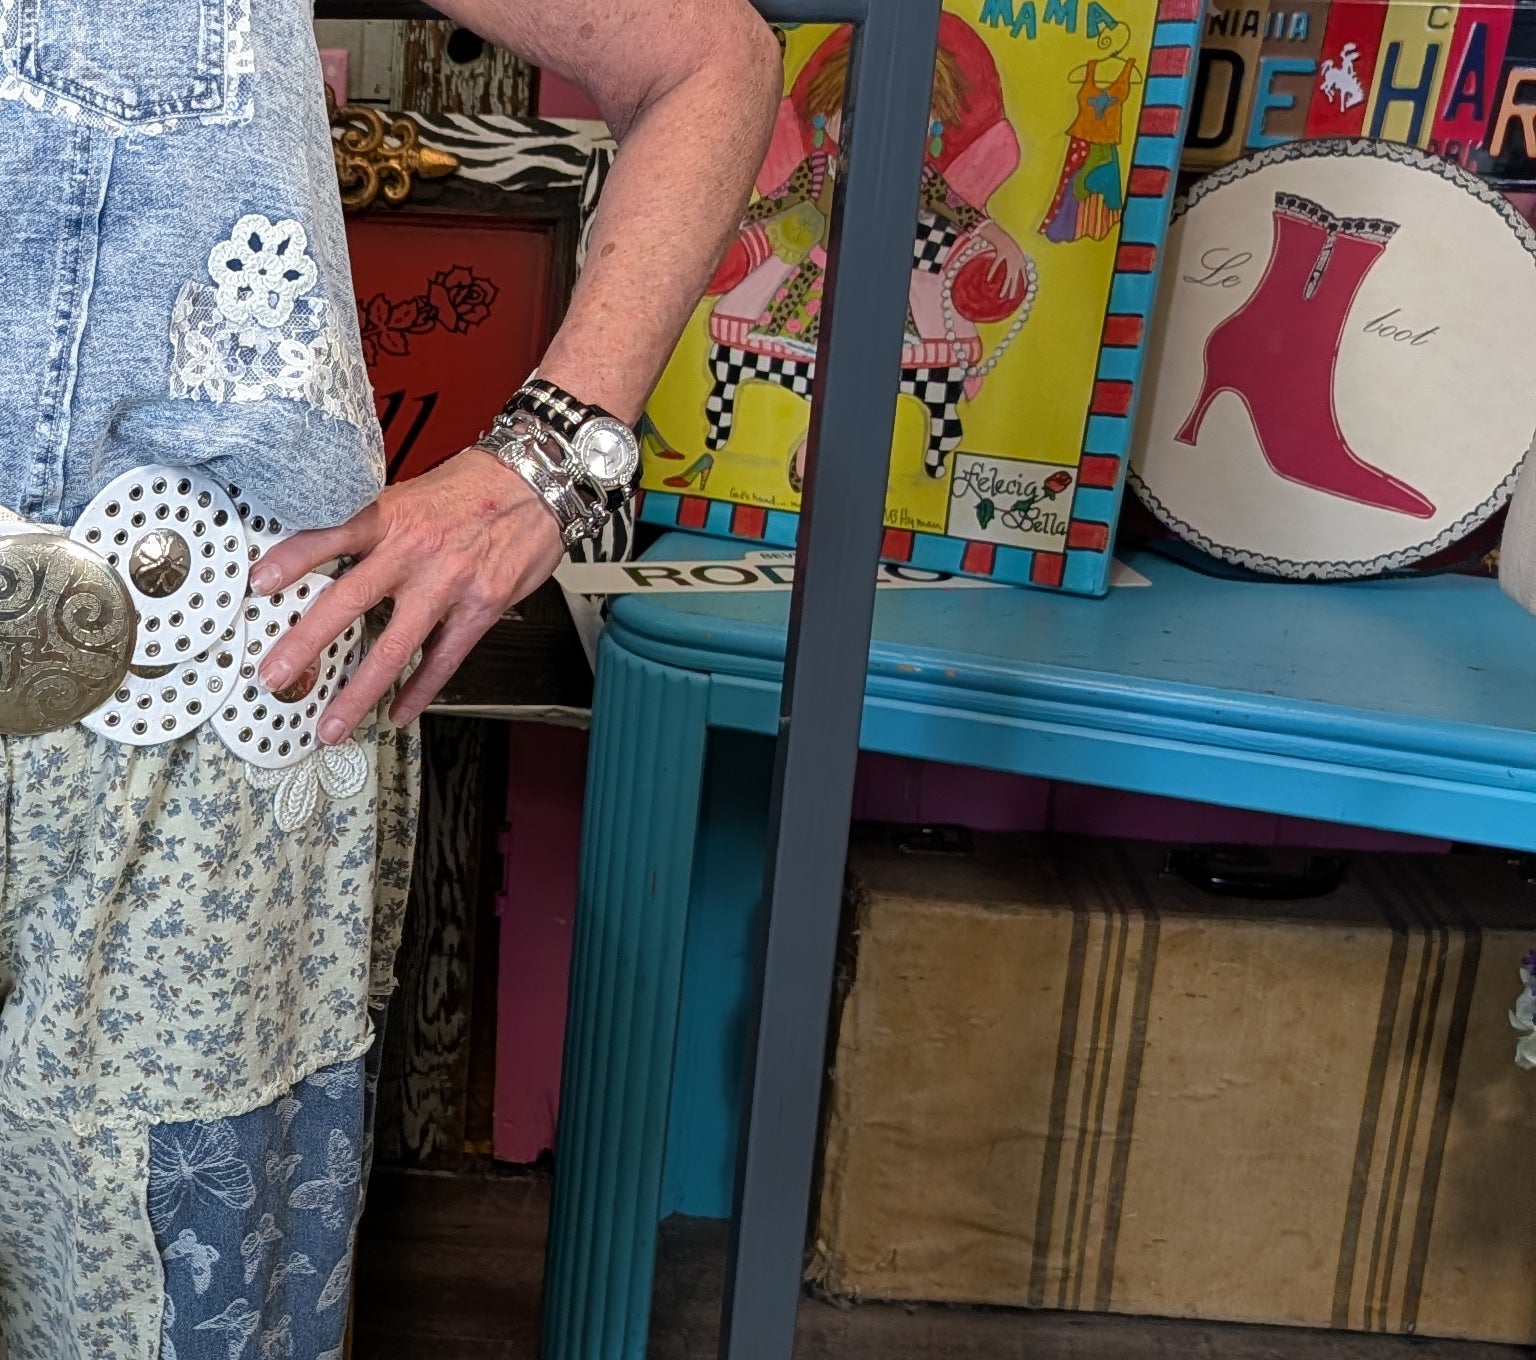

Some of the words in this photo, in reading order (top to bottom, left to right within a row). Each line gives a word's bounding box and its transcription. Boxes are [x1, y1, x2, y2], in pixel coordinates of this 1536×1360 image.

[1183, 248, 1252, 288] Le
[1363, 308, 1440, 346] boot
[952, 462, 1038, 500] Felecia
[1001, 506, 1069, 536] Bella
[622, 564, 956, 587] RODO
